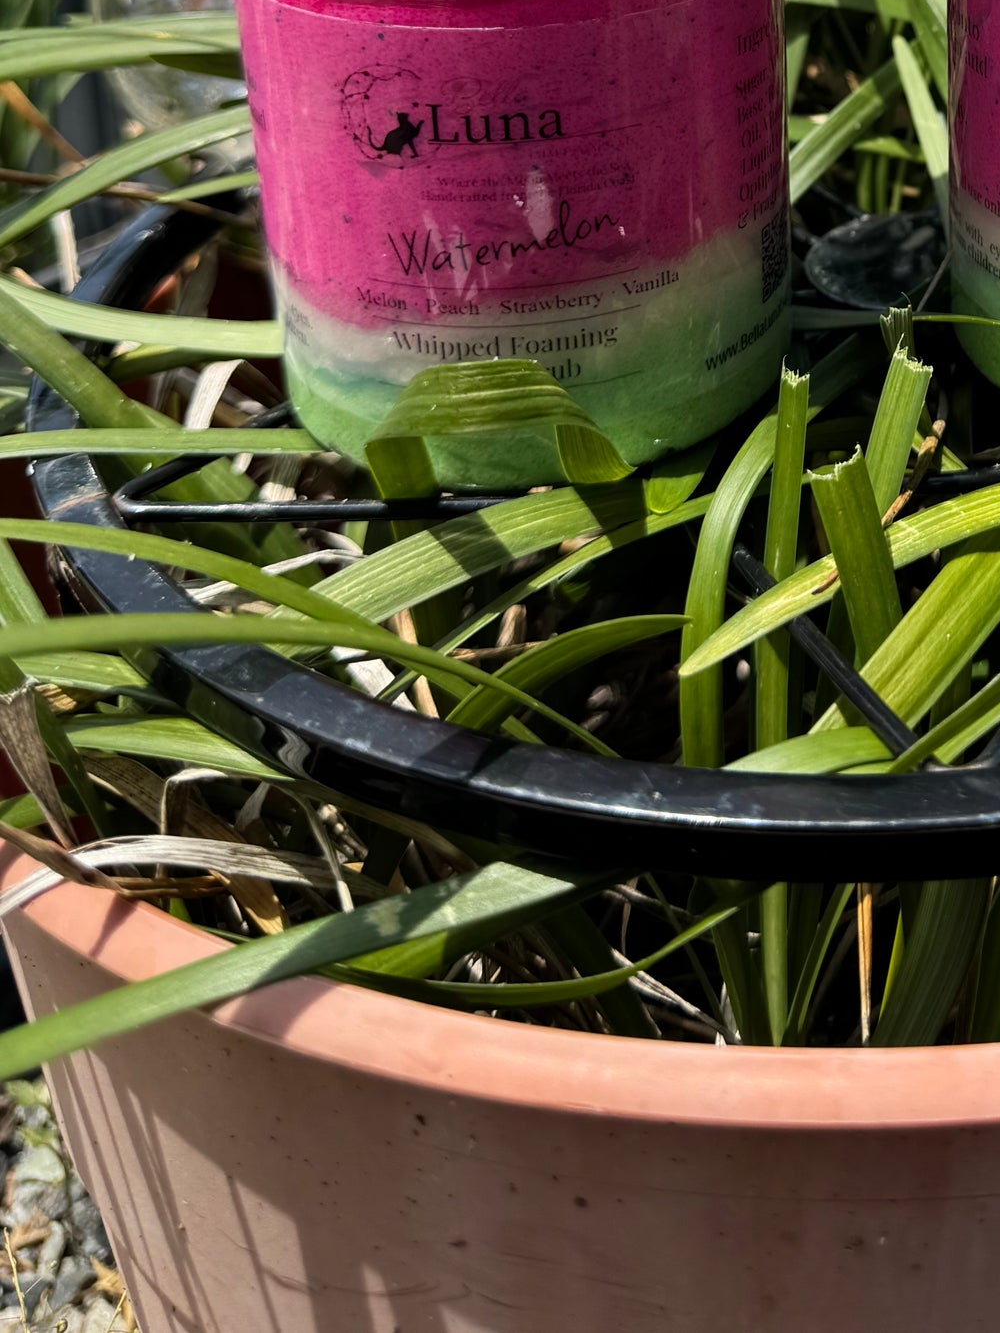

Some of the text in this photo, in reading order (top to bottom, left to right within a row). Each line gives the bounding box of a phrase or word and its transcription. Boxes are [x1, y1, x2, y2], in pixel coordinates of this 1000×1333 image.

[424, 103, 567, 144] Luna
[386, 199, 620, 277] Watermelon
[356, 269, 681, 316] Melon Peach Strawberry Vanilla
[392, 324, 620, 361] Whipped Foaming
